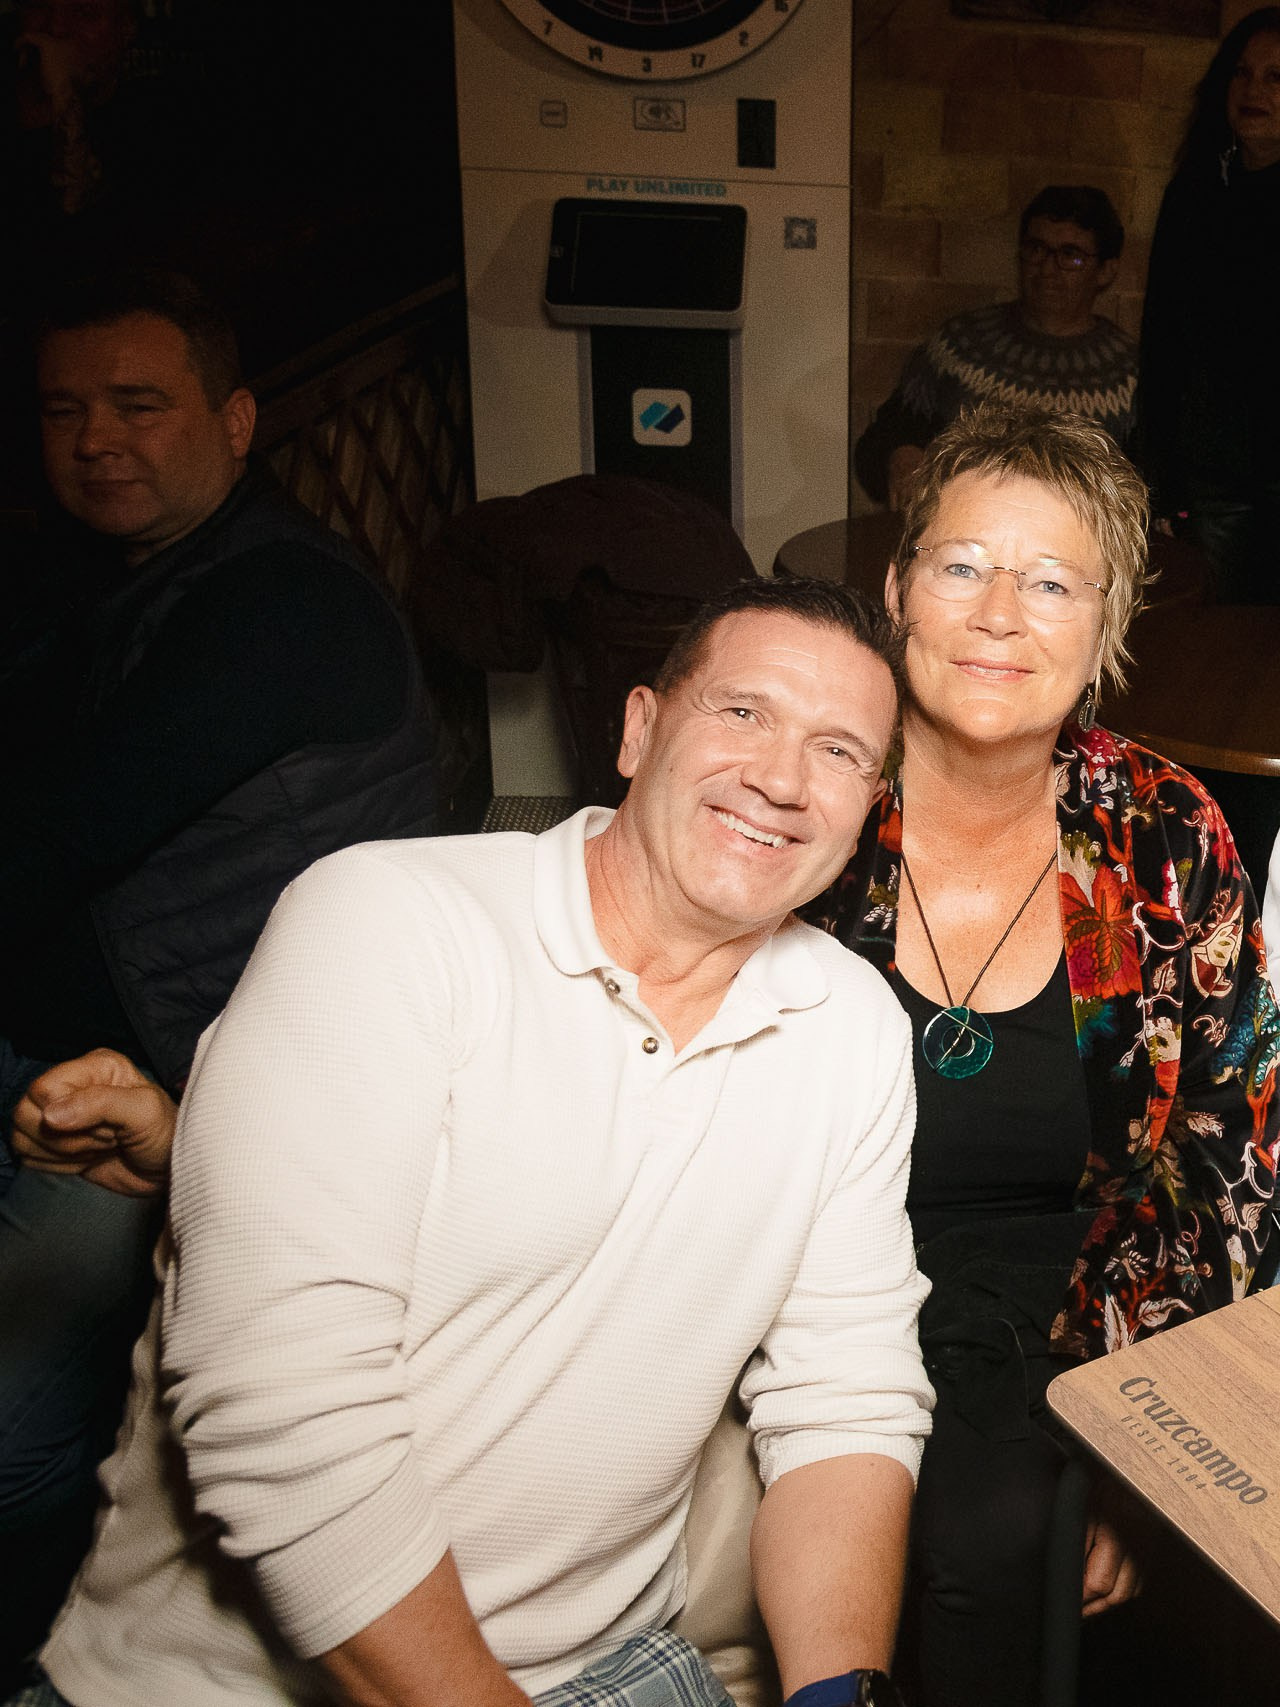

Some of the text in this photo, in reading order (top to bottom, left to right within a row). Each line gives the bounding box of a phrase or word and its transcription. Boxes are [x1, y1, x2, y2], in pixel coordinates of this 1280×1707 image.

[543, 19, 553, 35] 7
[738, 30, 749, 47] 2
[642, 57, 652, 72] 3
[691, 52, 706, 68] 17
[586, 177, 727, 197] PLAY UNLIMITED
[1119, 1376, 1268, 1505] Cruzcampo
[1120, 1415, 1166, 1453] DESDE
